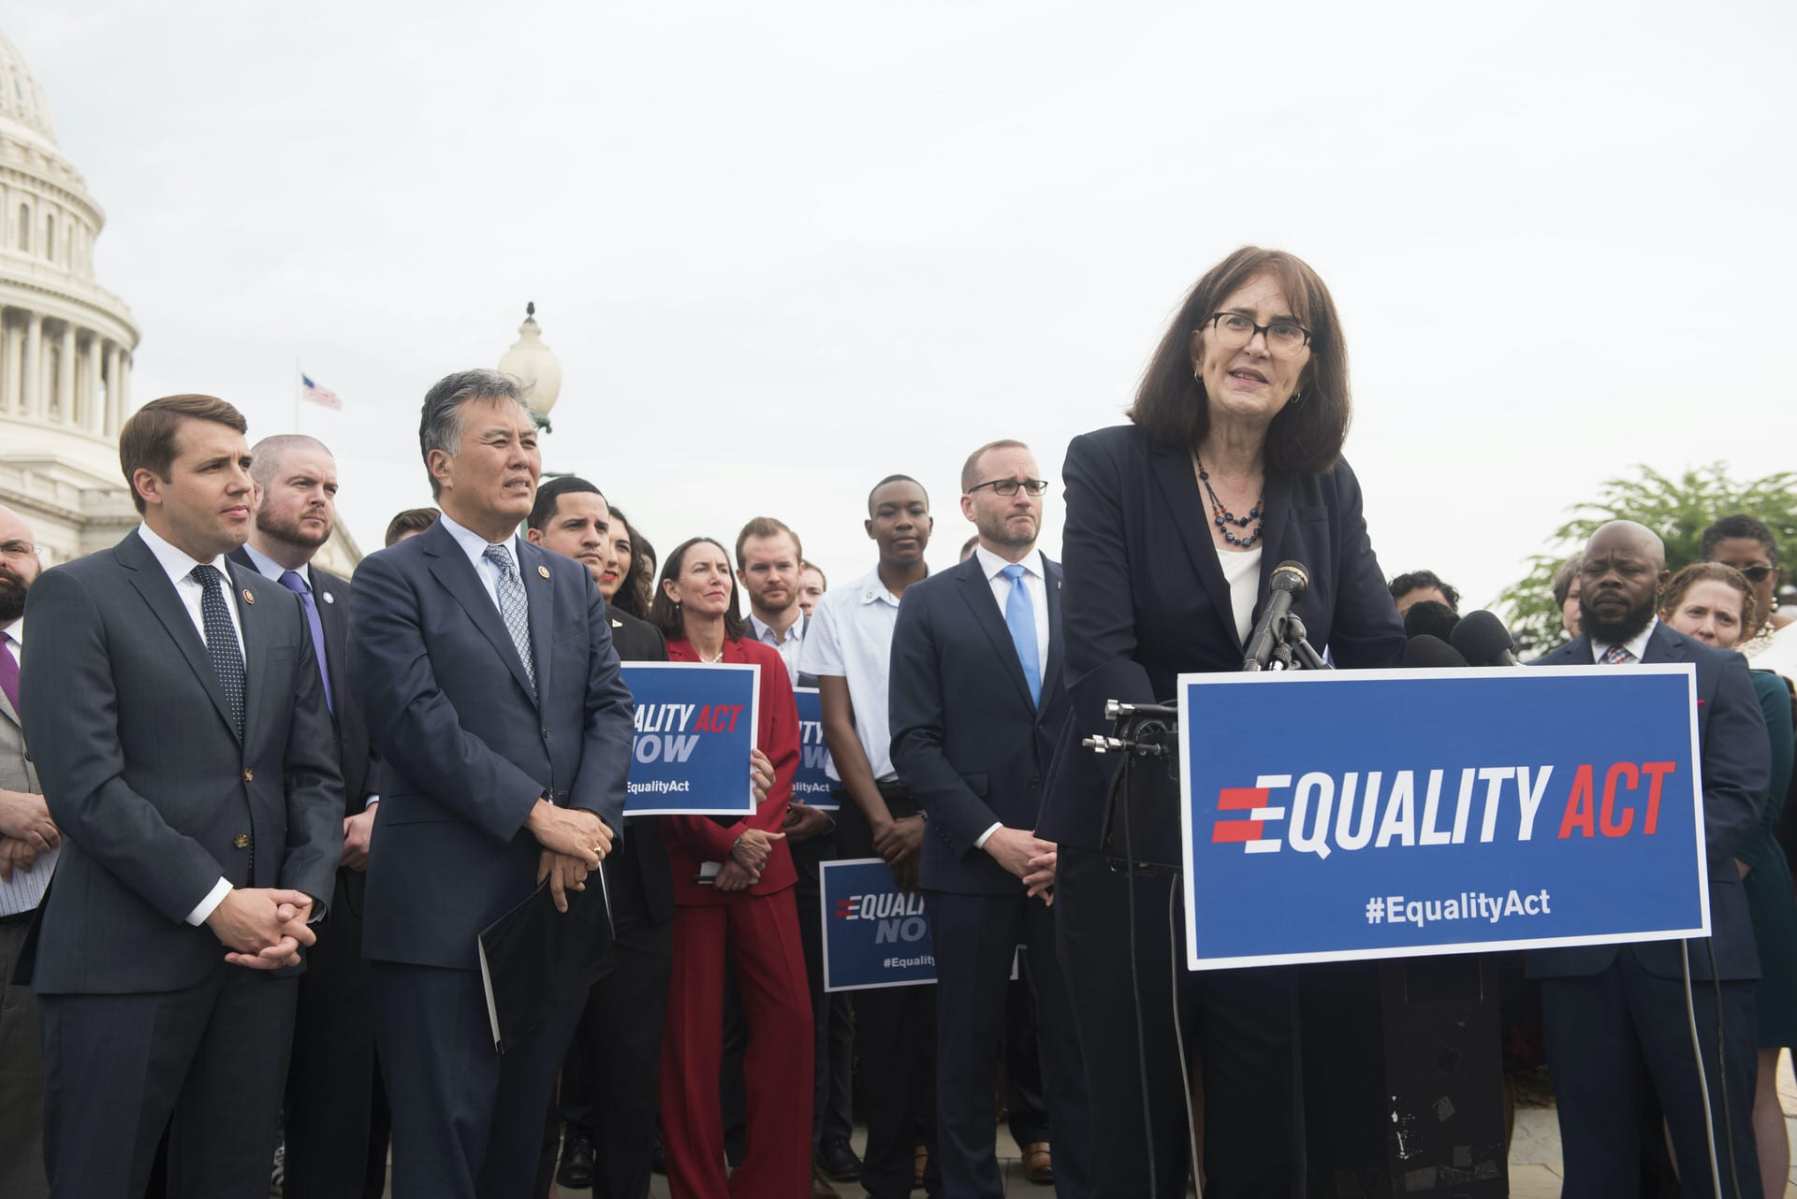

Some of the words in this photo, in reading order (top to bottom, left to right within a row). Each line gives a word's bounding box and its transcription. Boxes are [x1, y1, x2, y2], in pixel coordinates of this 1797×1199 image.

[633, 703, 696, 733] ALITY
[692, 703, 745, 734] ACT
[1243, 764, 1555, 860] EQUALITY
[1556, 760, 1677, 840] ACT
[1365, 889, 1551, 928] #EqualityAct
